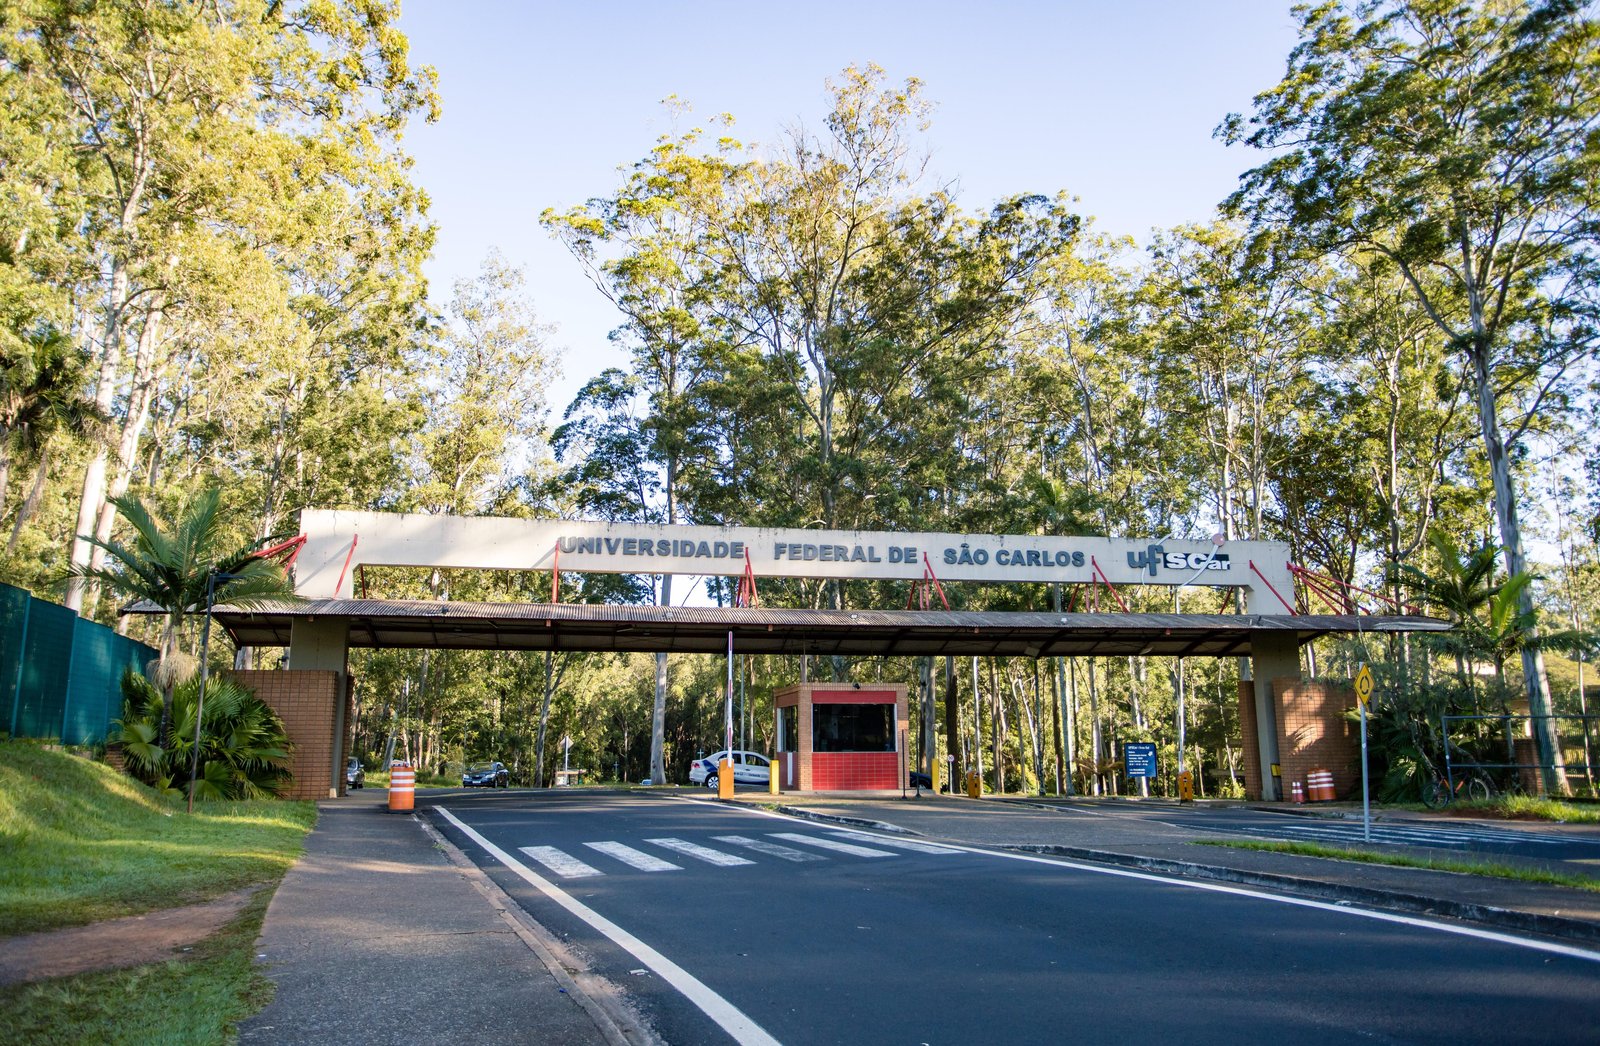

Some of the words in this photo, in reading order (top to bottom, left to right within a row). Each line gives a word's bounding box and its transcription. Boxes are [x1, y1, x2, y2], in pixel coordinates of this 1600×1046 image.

[559, 536, 744, 559] UNIVERSIDADE
[774, 542, 881, 563] FEDERAL
[889, 546, 918, 564] DE
[943, 543, 989, 566] SÃO
[995, 549, 1085, 568] CARLOS
